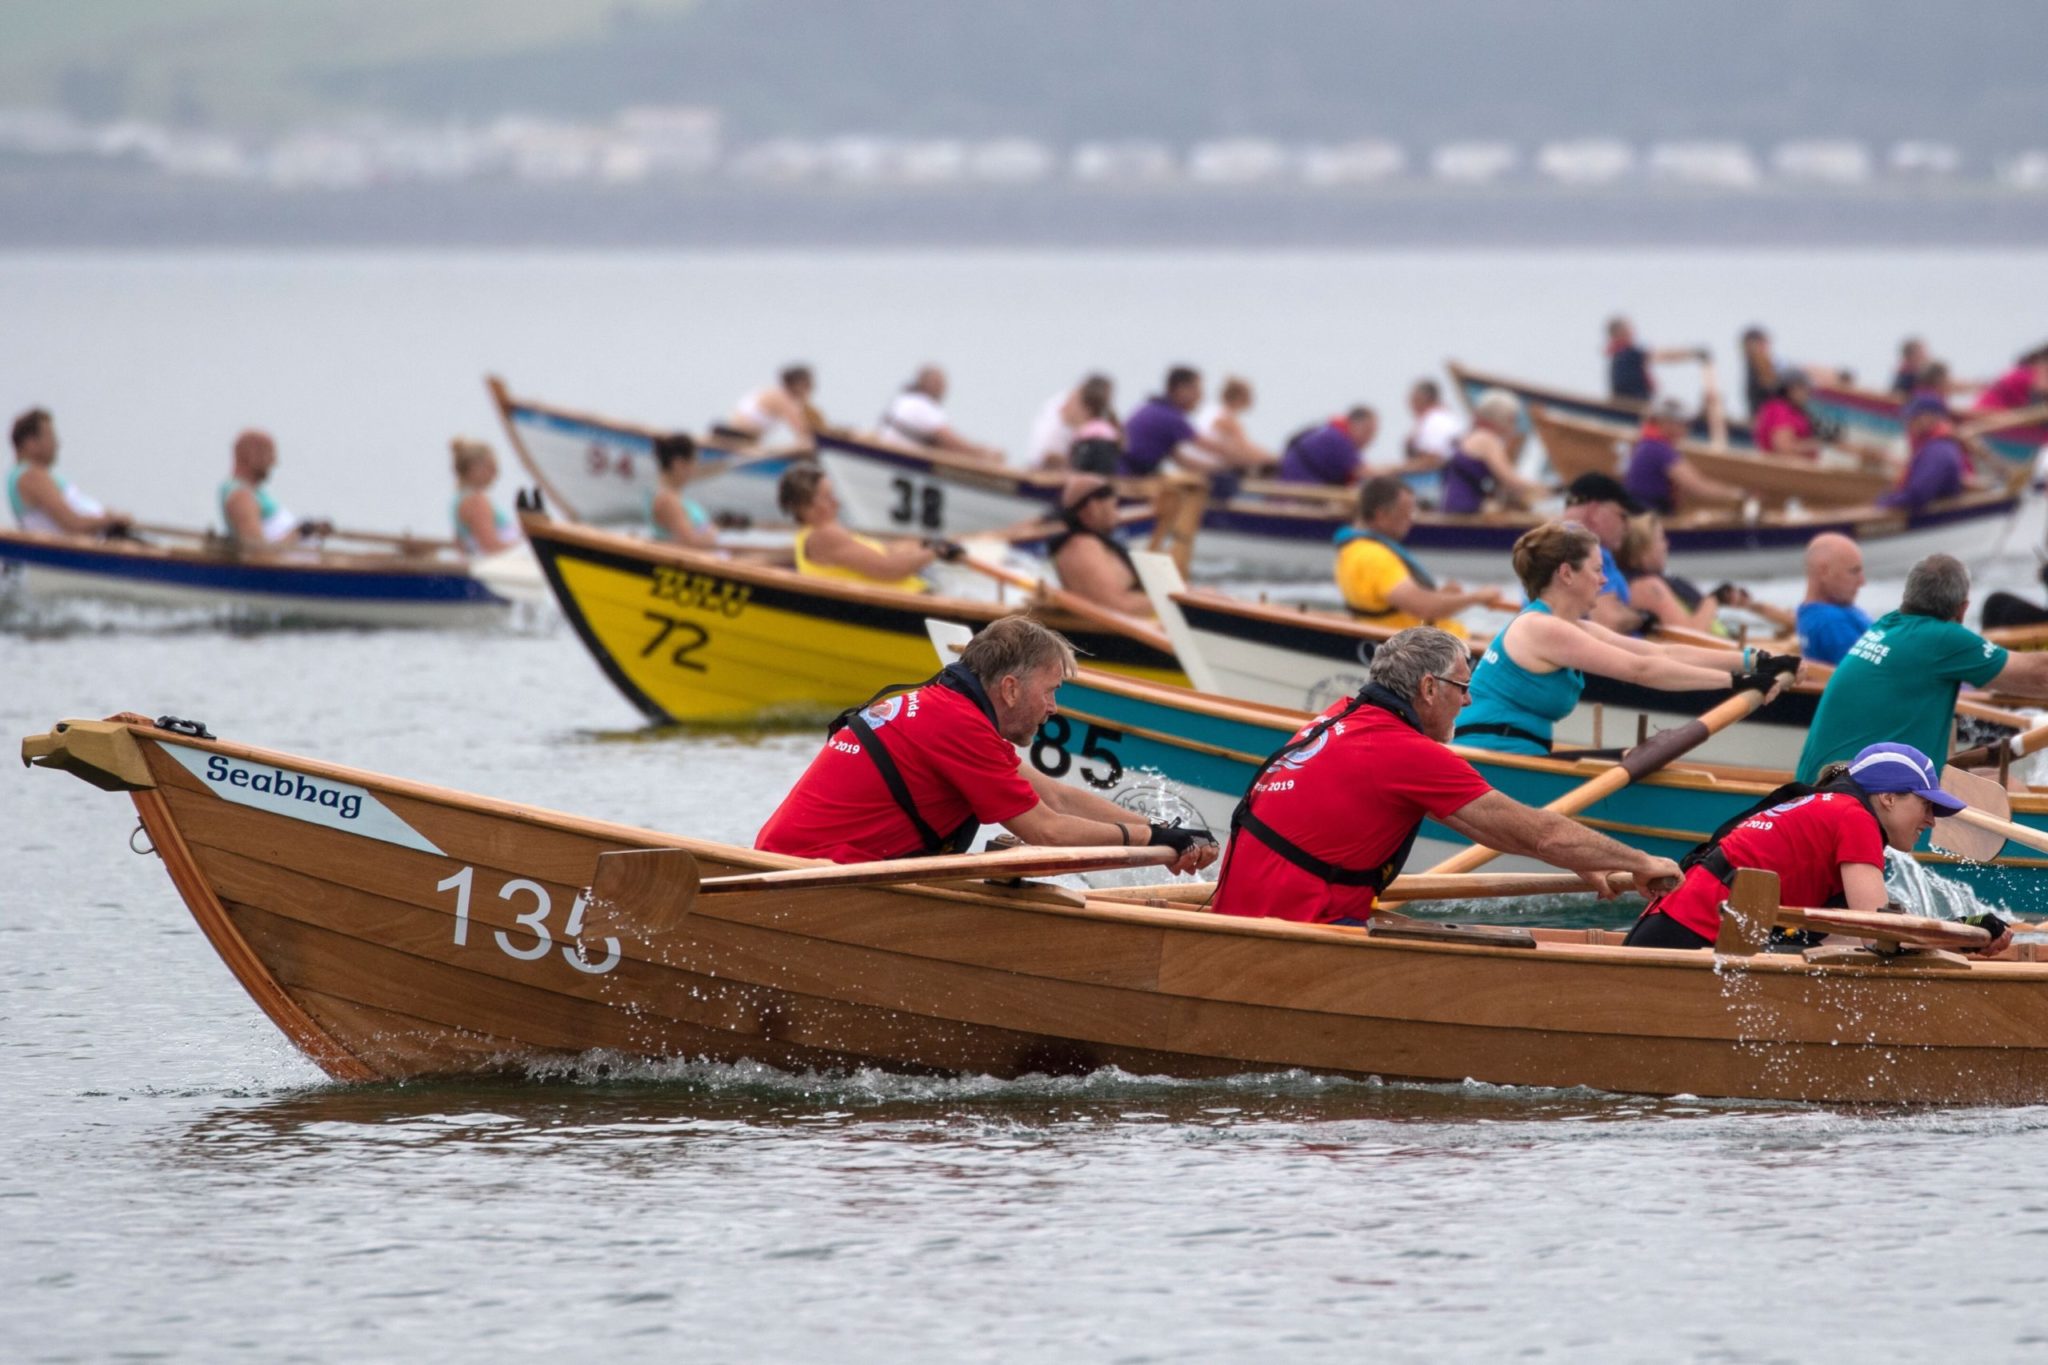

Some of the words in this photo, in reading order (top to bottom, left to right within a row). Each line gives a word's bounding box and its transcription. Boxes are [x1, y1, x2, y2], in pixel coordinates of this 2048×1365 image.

[890, 477, 943, 529] 38
[650, 566, 752, 619] ZULU
[640, 610, 708, 674] 72
[835, 741, 860, 755] 2019
[1030, 713, 1124, 790] 85
[206, 755, 363, 820] Seabhag
[1267, 780, 1294, 792] 2019
[1748, 820, 1773, 831] 2019
[437, 866, 621, 974] 135
